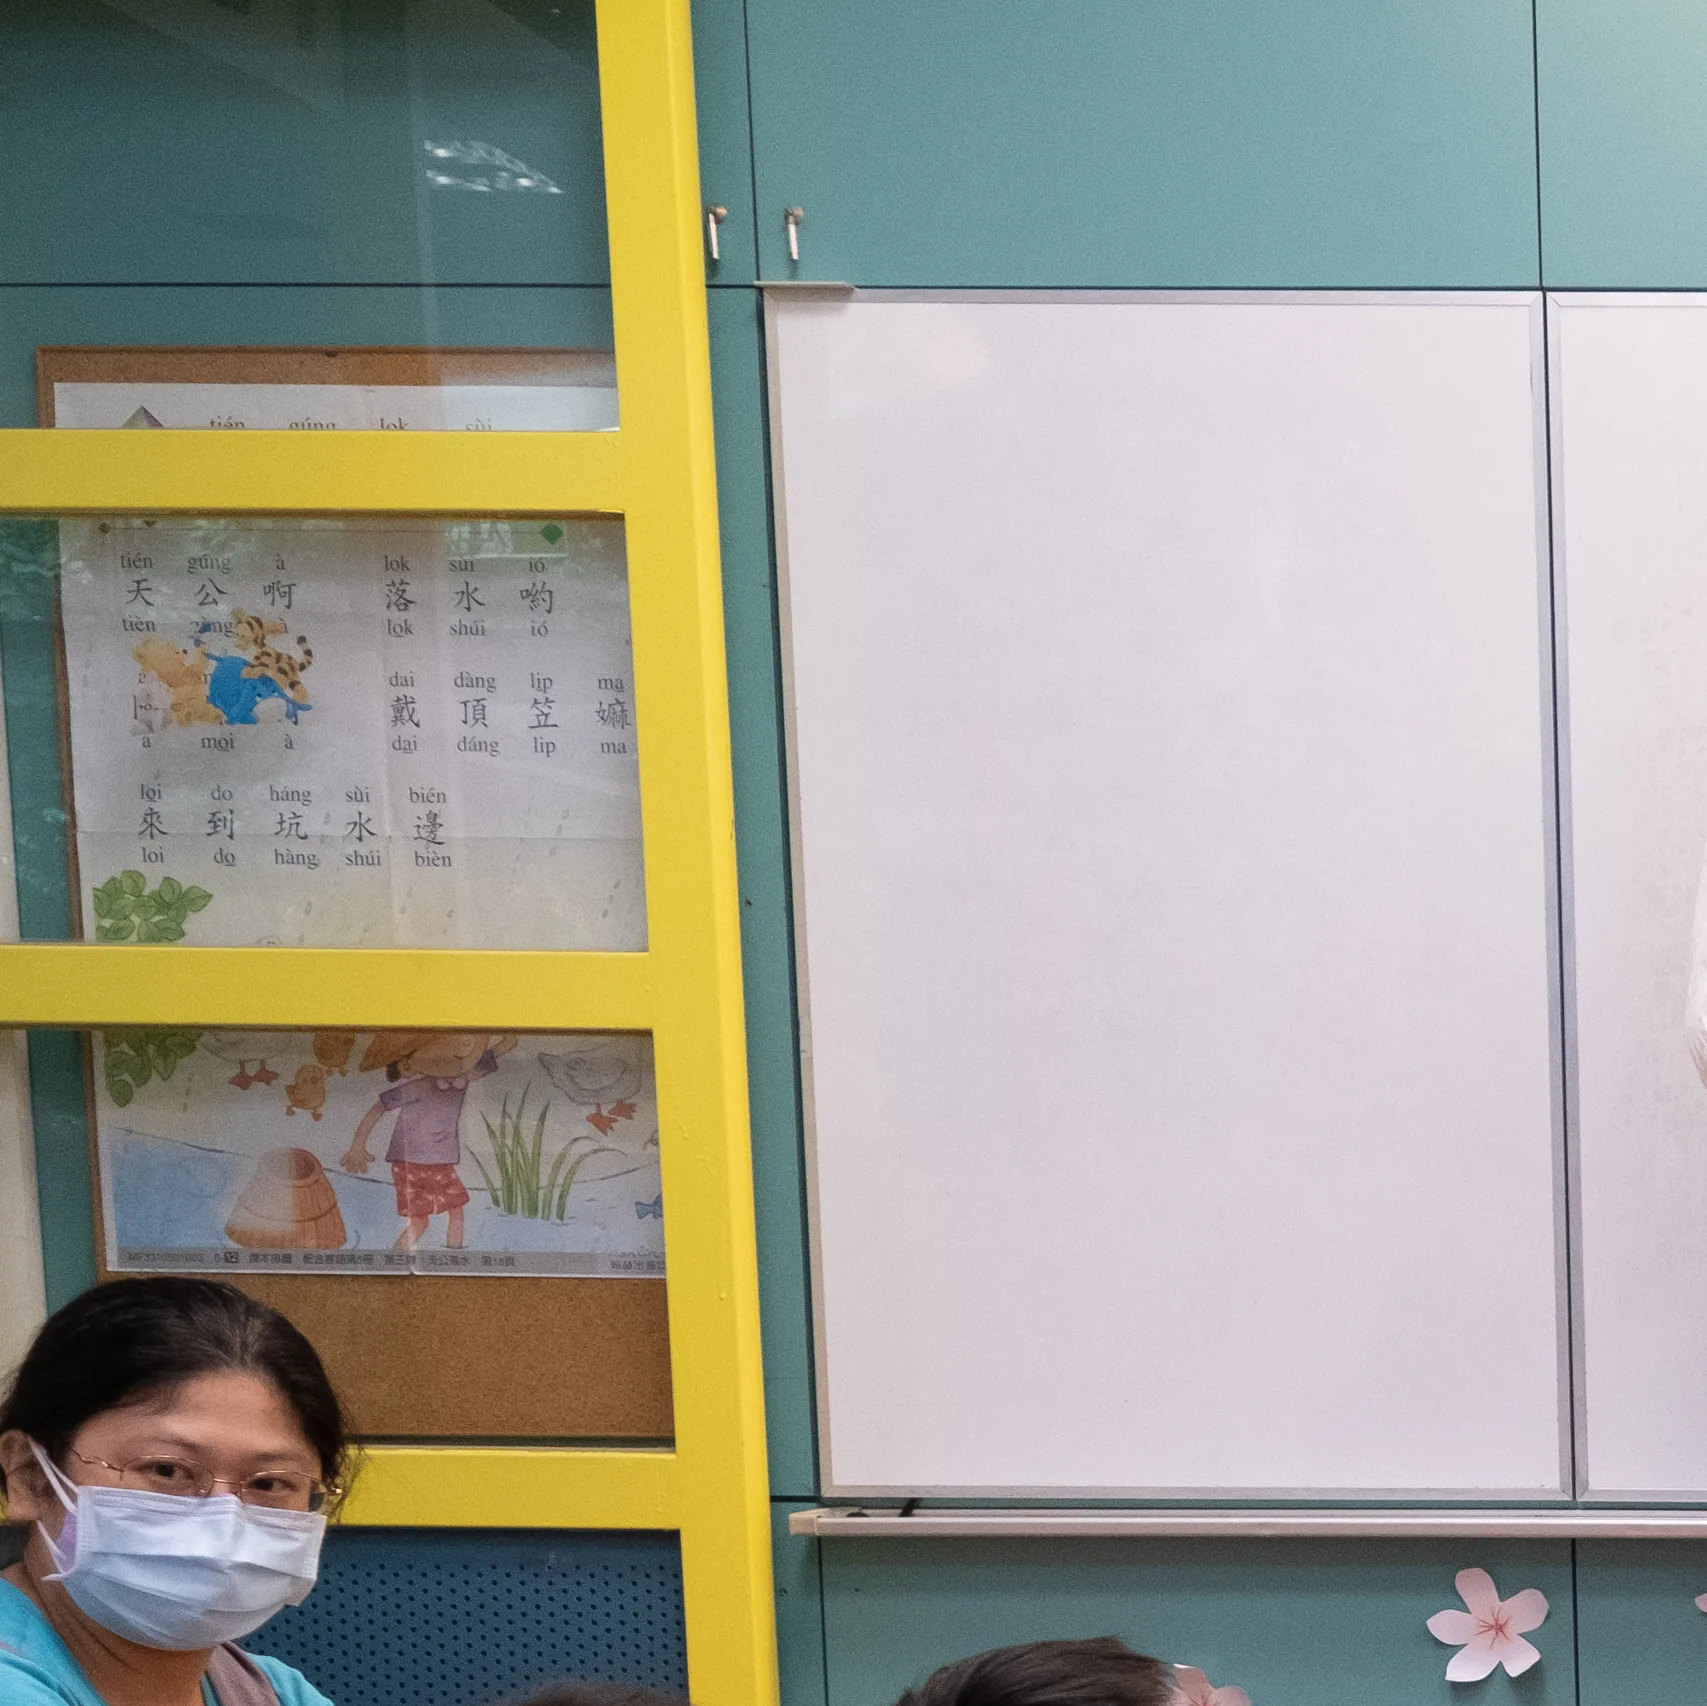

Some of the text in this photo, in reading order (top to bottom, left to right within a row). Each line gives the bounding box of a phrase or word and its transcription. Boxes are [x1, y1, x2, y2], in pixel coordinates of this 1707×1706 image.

[126, 578, 154, 606] 天
[195, 577, 229, 607] 公
[263, 580, 297, 610] 啊
[385, 579, 417, 612] 落
[454, 580, 487, 613] 水
[389, 671, 415, 687] dai
[390, 694, 421, 729] 戴
[460, 697, 489, 729] 頂
[528, 696, 560, 729] 笠
[138, 807, 445, 845] 來 到 坑 水 邊
